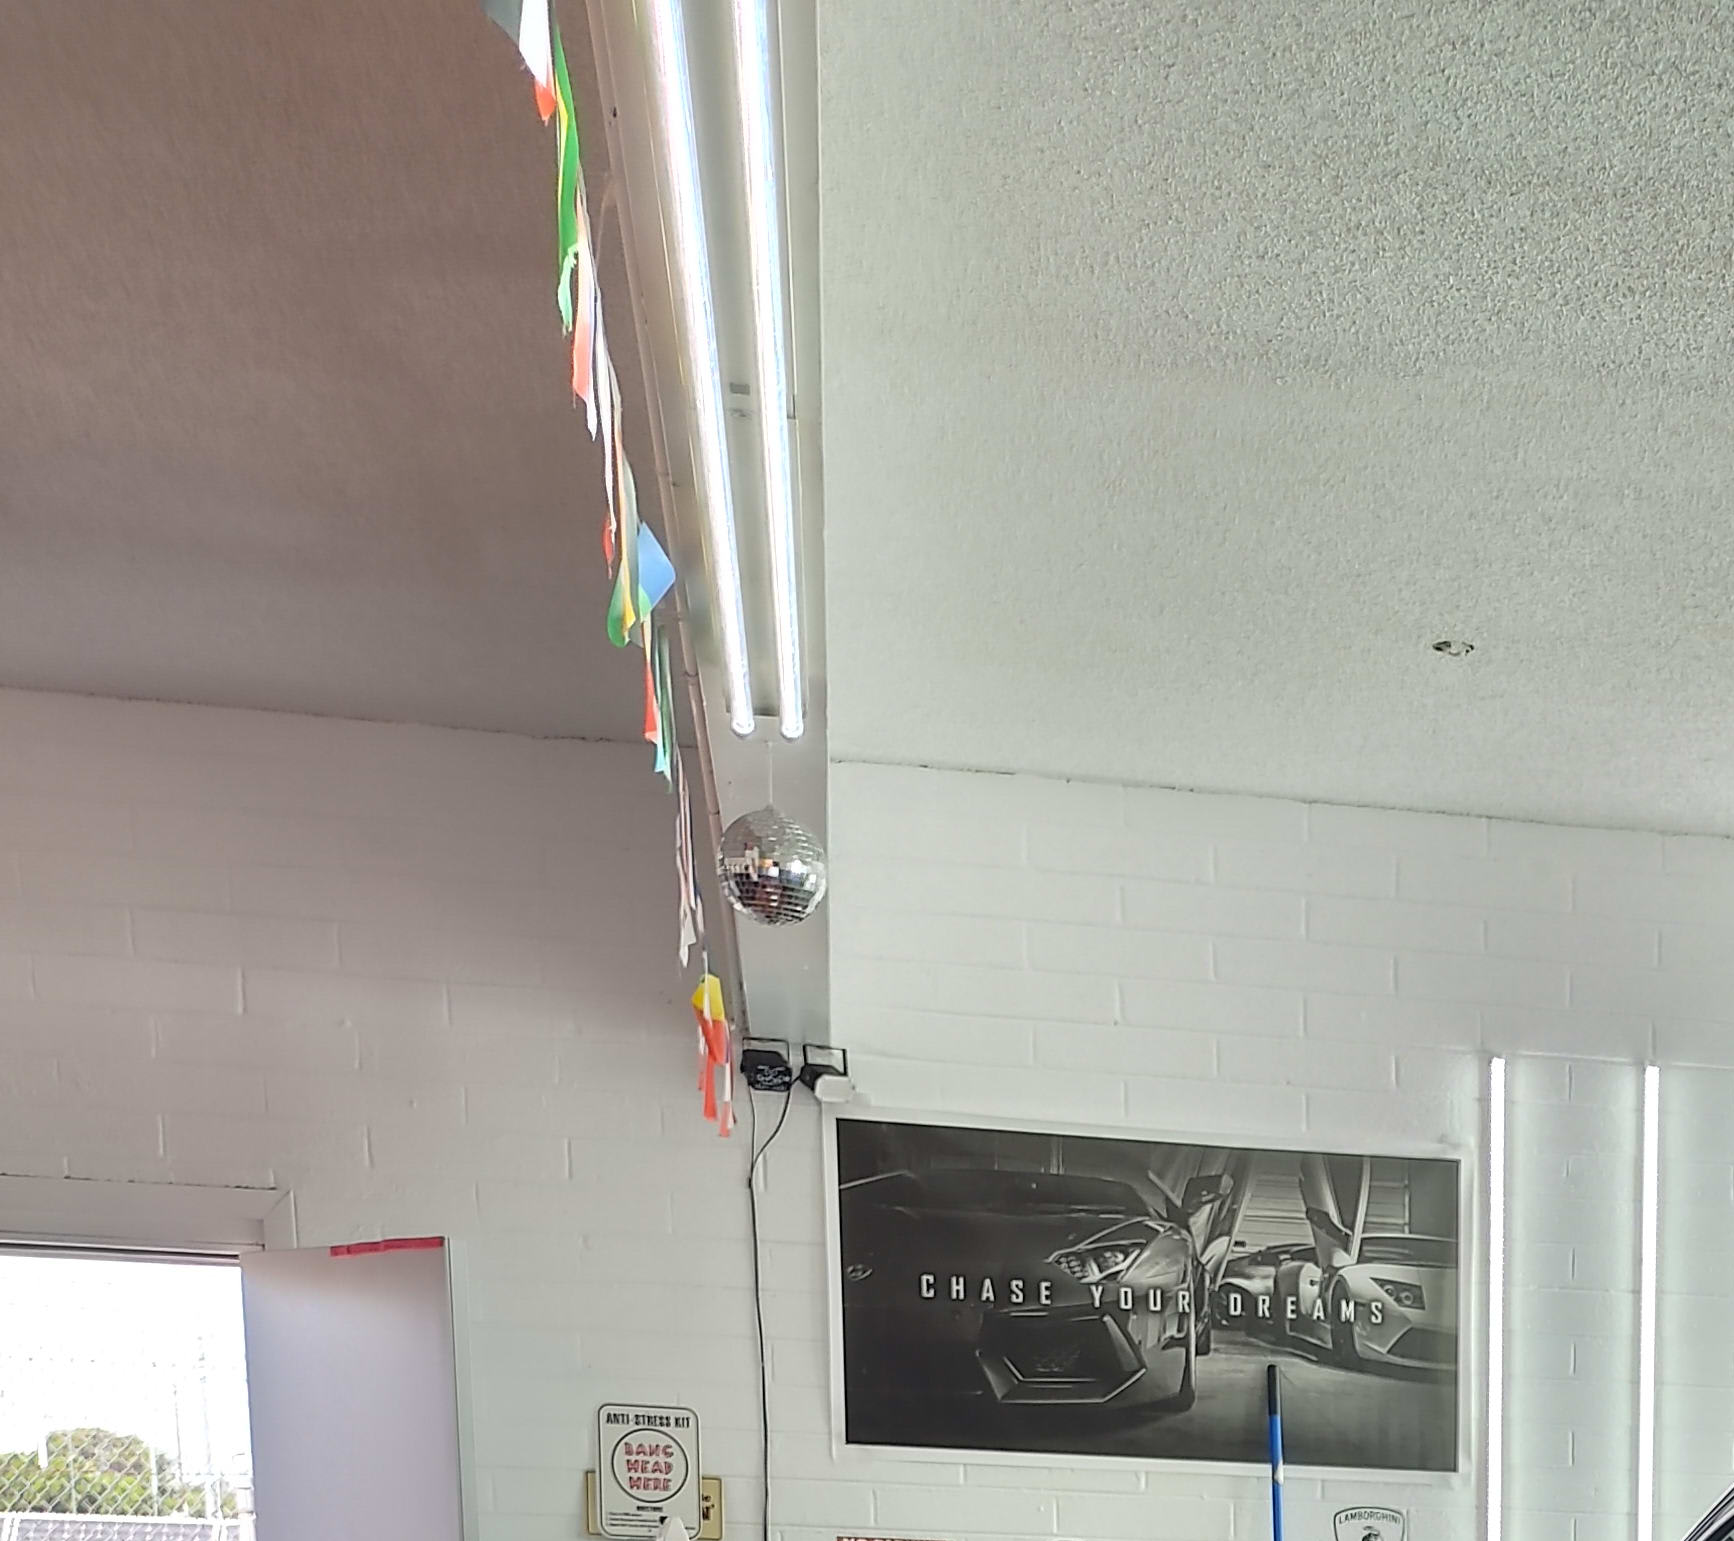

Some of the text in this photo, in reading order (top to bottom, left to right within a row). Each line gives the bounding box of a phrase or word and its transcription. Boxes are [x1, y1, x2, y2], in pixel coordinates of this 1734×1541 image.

[920, 1274, 1384, 1324] CHASE YOUR DREAMS
[674, 1416, 691, 1428] KIT
[624, 1442, 674, 1458] BANG
[626, 1459, 674, 1475] HEAD
[628, 1476, 672, 1491] HERE
